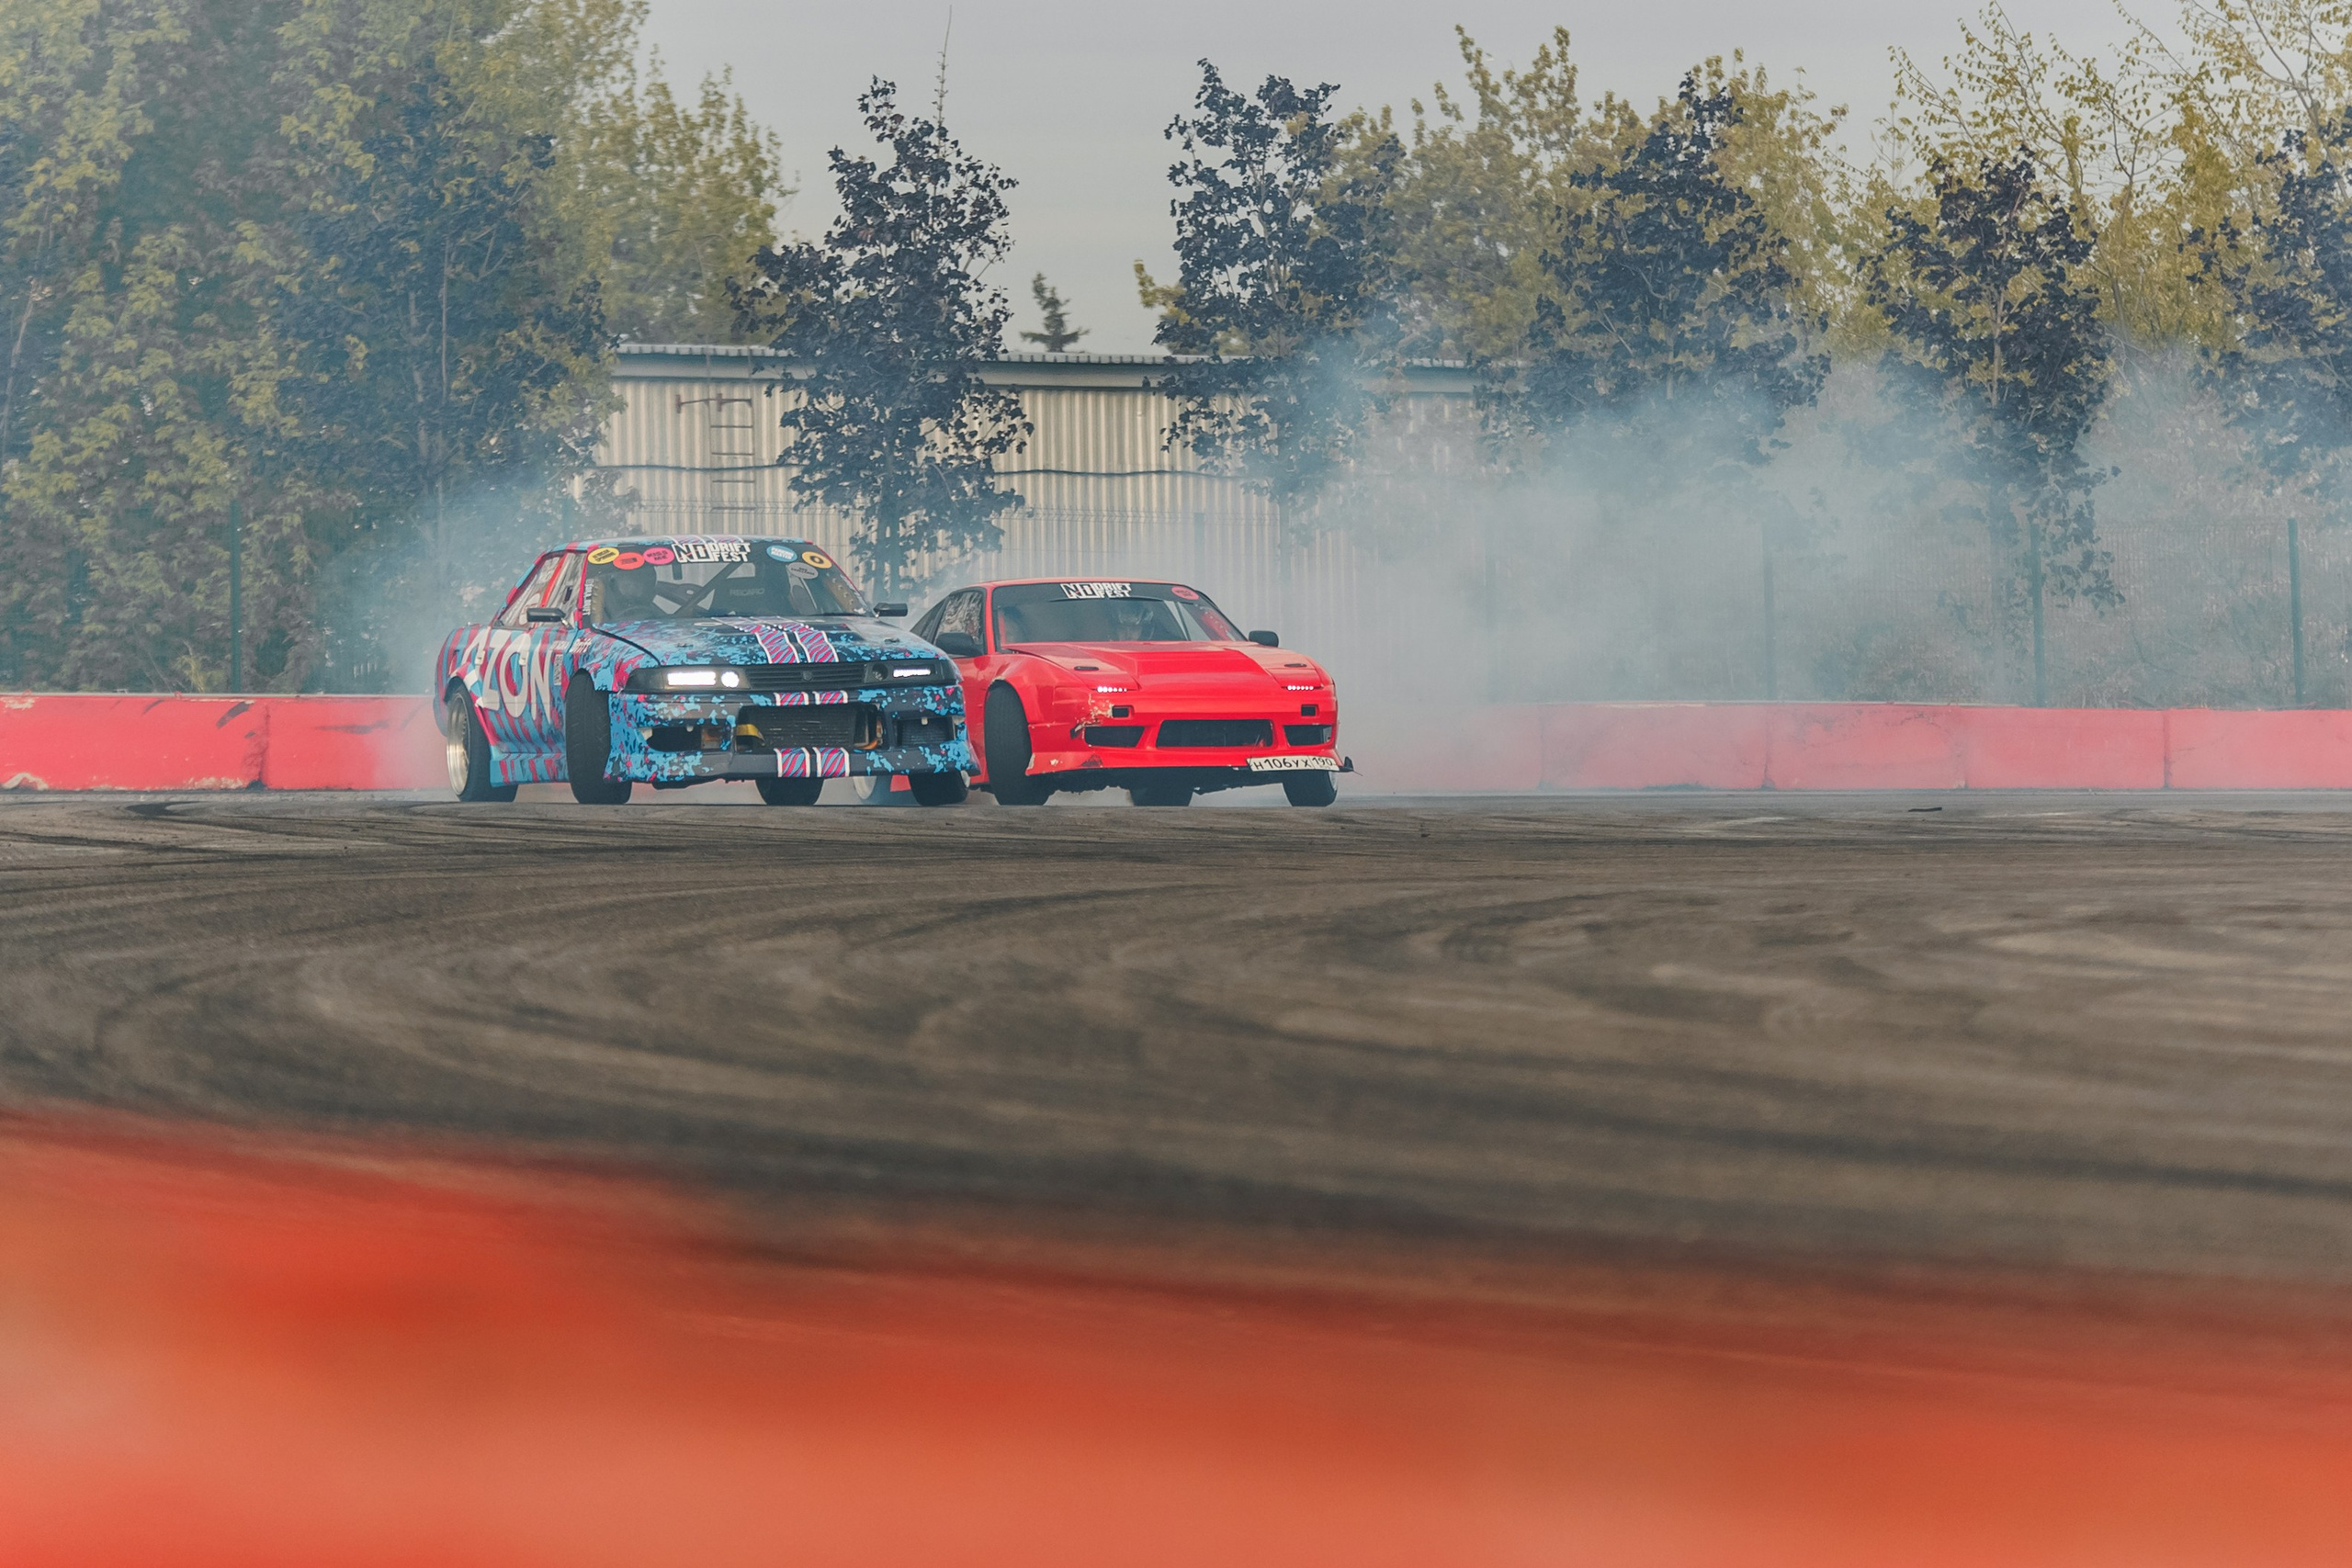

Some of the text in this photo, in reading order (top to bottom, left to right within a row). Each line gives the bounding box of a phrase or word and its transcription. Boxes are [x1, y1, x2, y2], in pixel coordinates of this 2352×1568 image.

[708, 542, 751, 553] DRIFT
[712, 551, 749, 562] FEST
[1094, 582, 1132, 592] DRIFT
[1098, 590, 1131, 599] FEST
